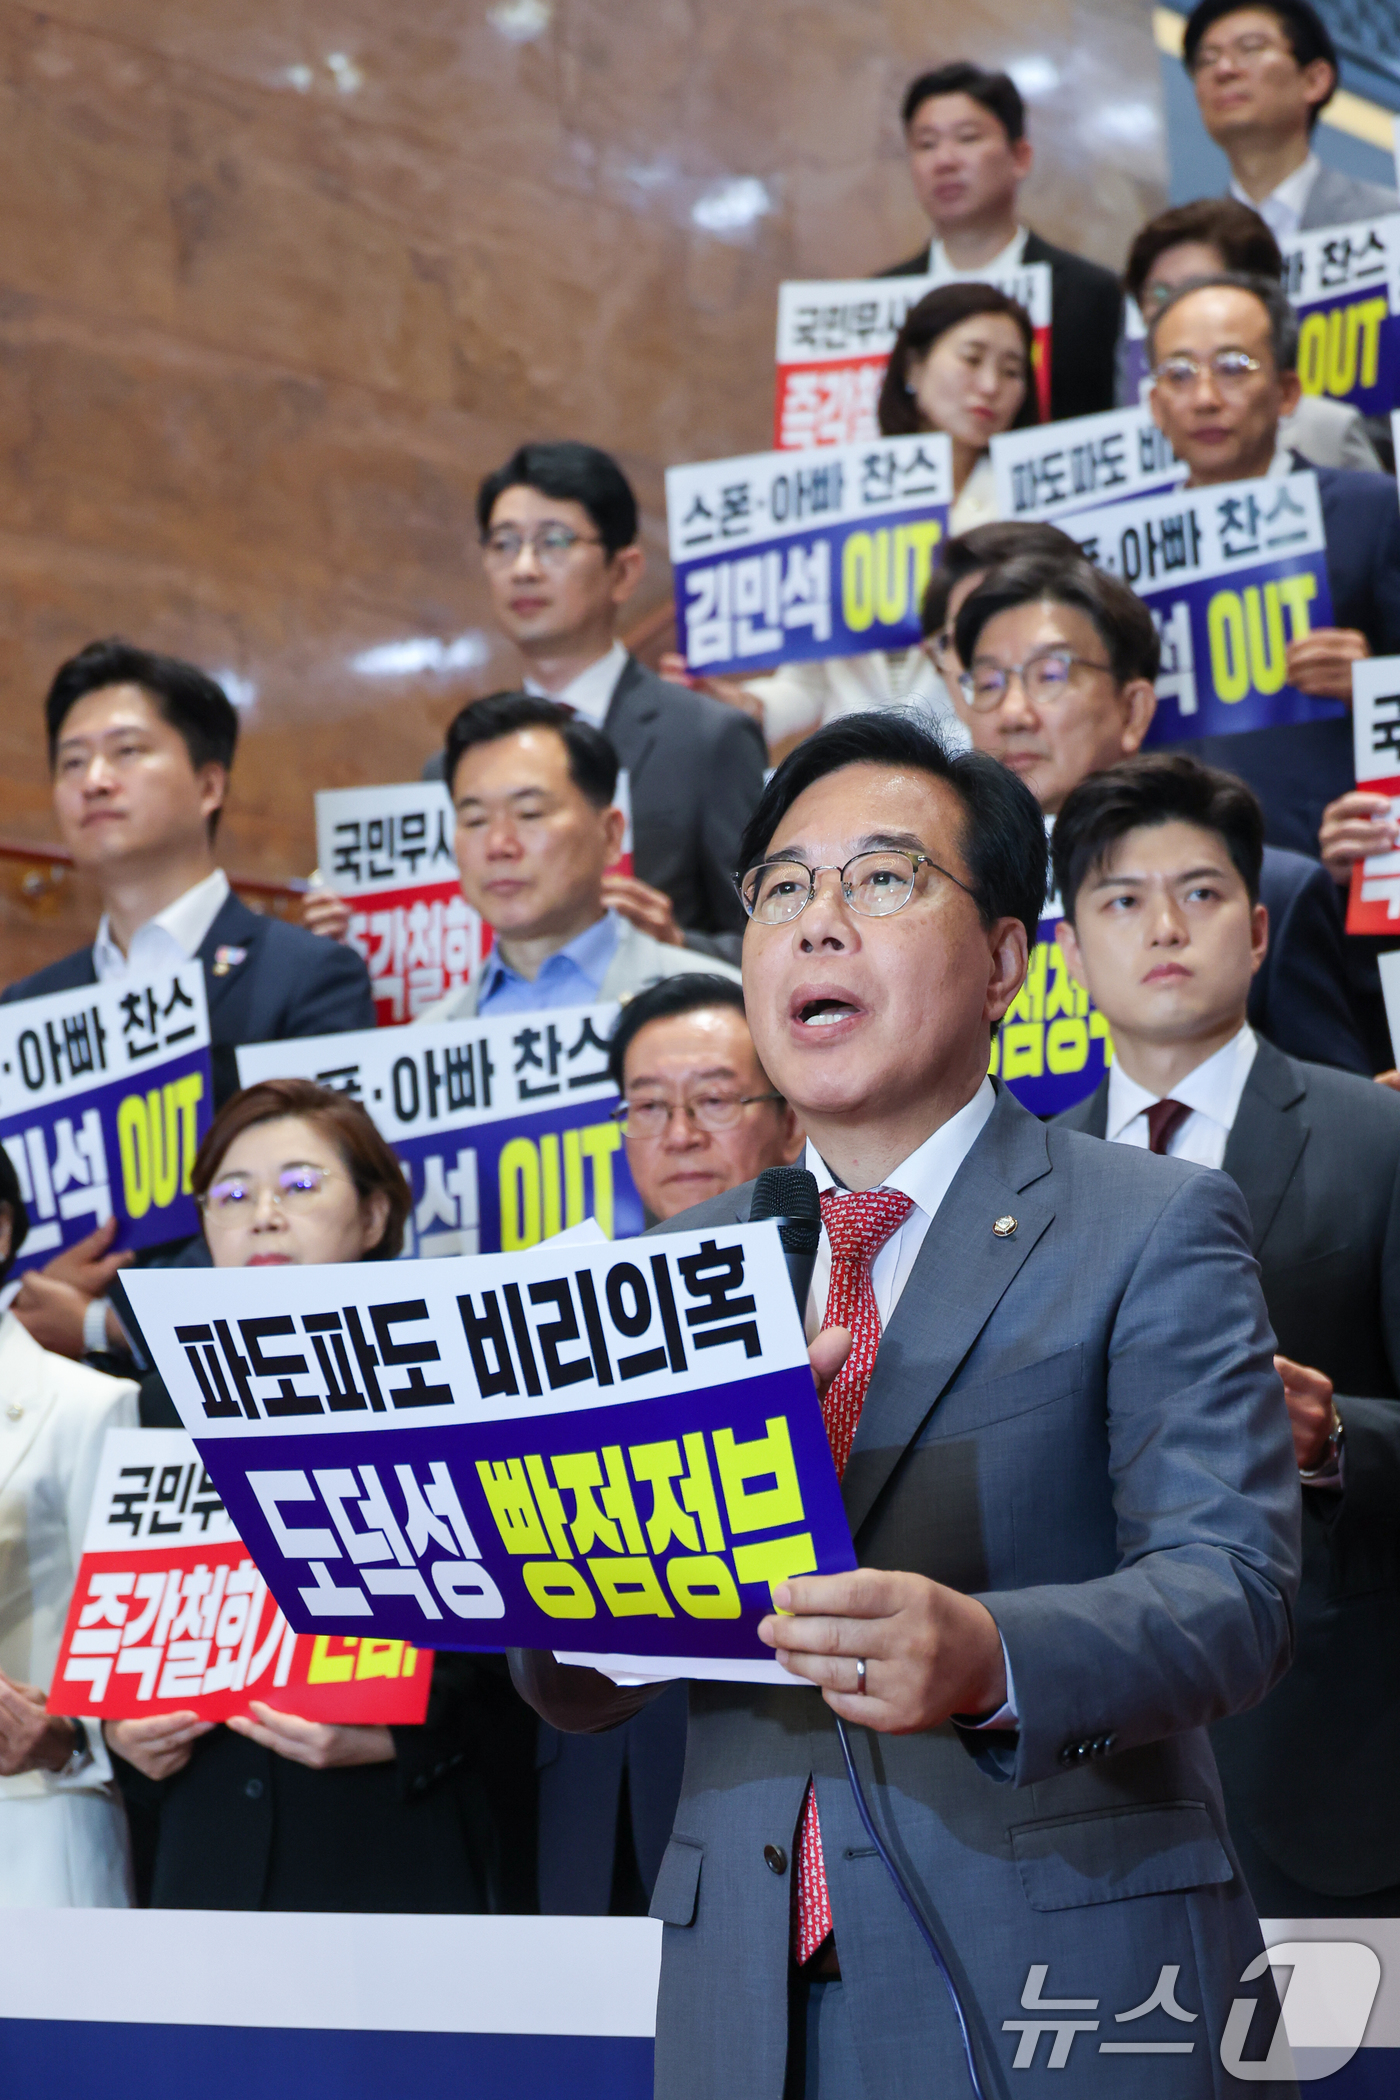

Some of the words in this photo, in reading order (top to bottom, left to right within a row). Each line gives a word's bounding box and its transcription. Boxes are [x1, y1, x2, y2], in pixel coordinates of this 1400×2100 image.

[1298, 297, 1388, 398] OUT
[862, 446, 937, 505] 찬스
[1011, 433, 1127, 513] 파도파도
[1216, 484, 1308, 562] 찬스
[685, 538, 833, 668] 김민석
[842, 519, 943, 633] OUT
[1207, 571, 1318, 704] OUT
[119, 977, 196, 1060] 찬스
[513, 1017, 613, 1101] 찬스
[117, 1071, 203, 1219] OUT
[500, 1122, 627, 1253] OUT
[174, 1298, 455, 1420] 파도파도
[456, 1239, 764, 1399] 비리의혹
[245, 1460, 506, 1620] 도덕성
[475, 1415, 819, 1620] 빵점정부
